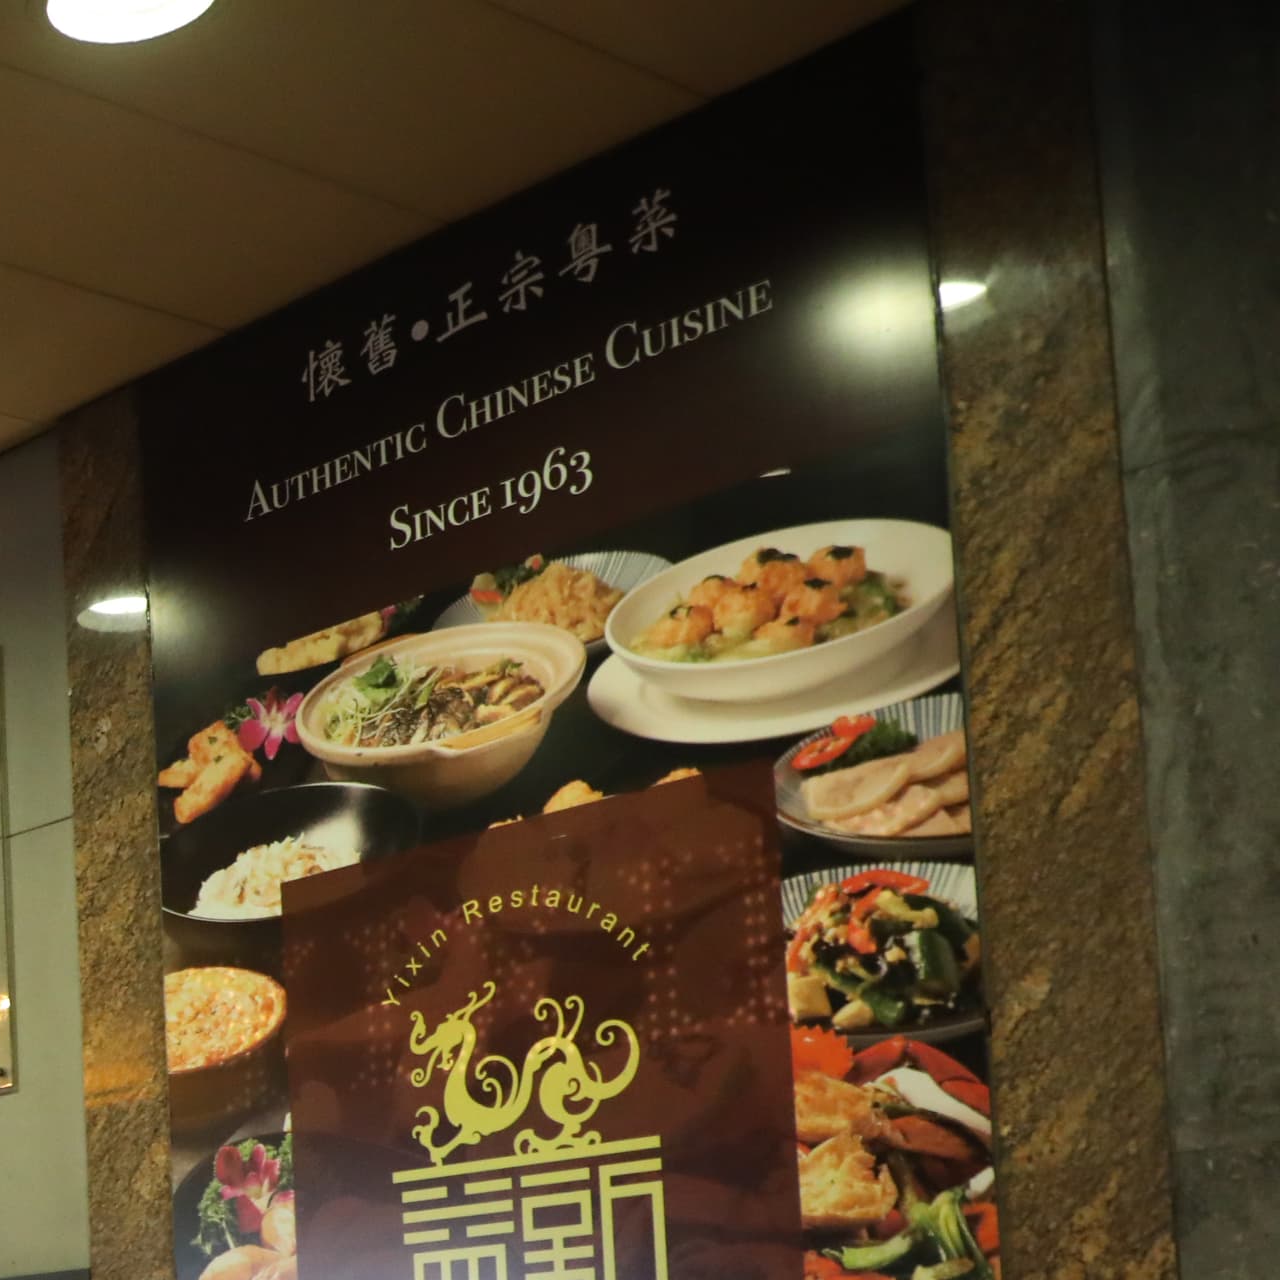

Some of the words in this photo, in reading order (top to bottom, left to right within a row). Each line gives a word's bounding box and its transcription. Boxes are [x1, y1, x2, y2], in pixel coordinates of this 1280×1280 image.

[244, 423, 427, 523] AUTHENTIC
[435, 352, 596, 441] CHINESE
[605, 279, 774, 371] CUISINE
[390, 488, 492, 550] SINCE
[500, 447, 594, 533] 1963
[381, 925, 448, 1010] Yixin
[461, 884, 652, 962] Restaurant
